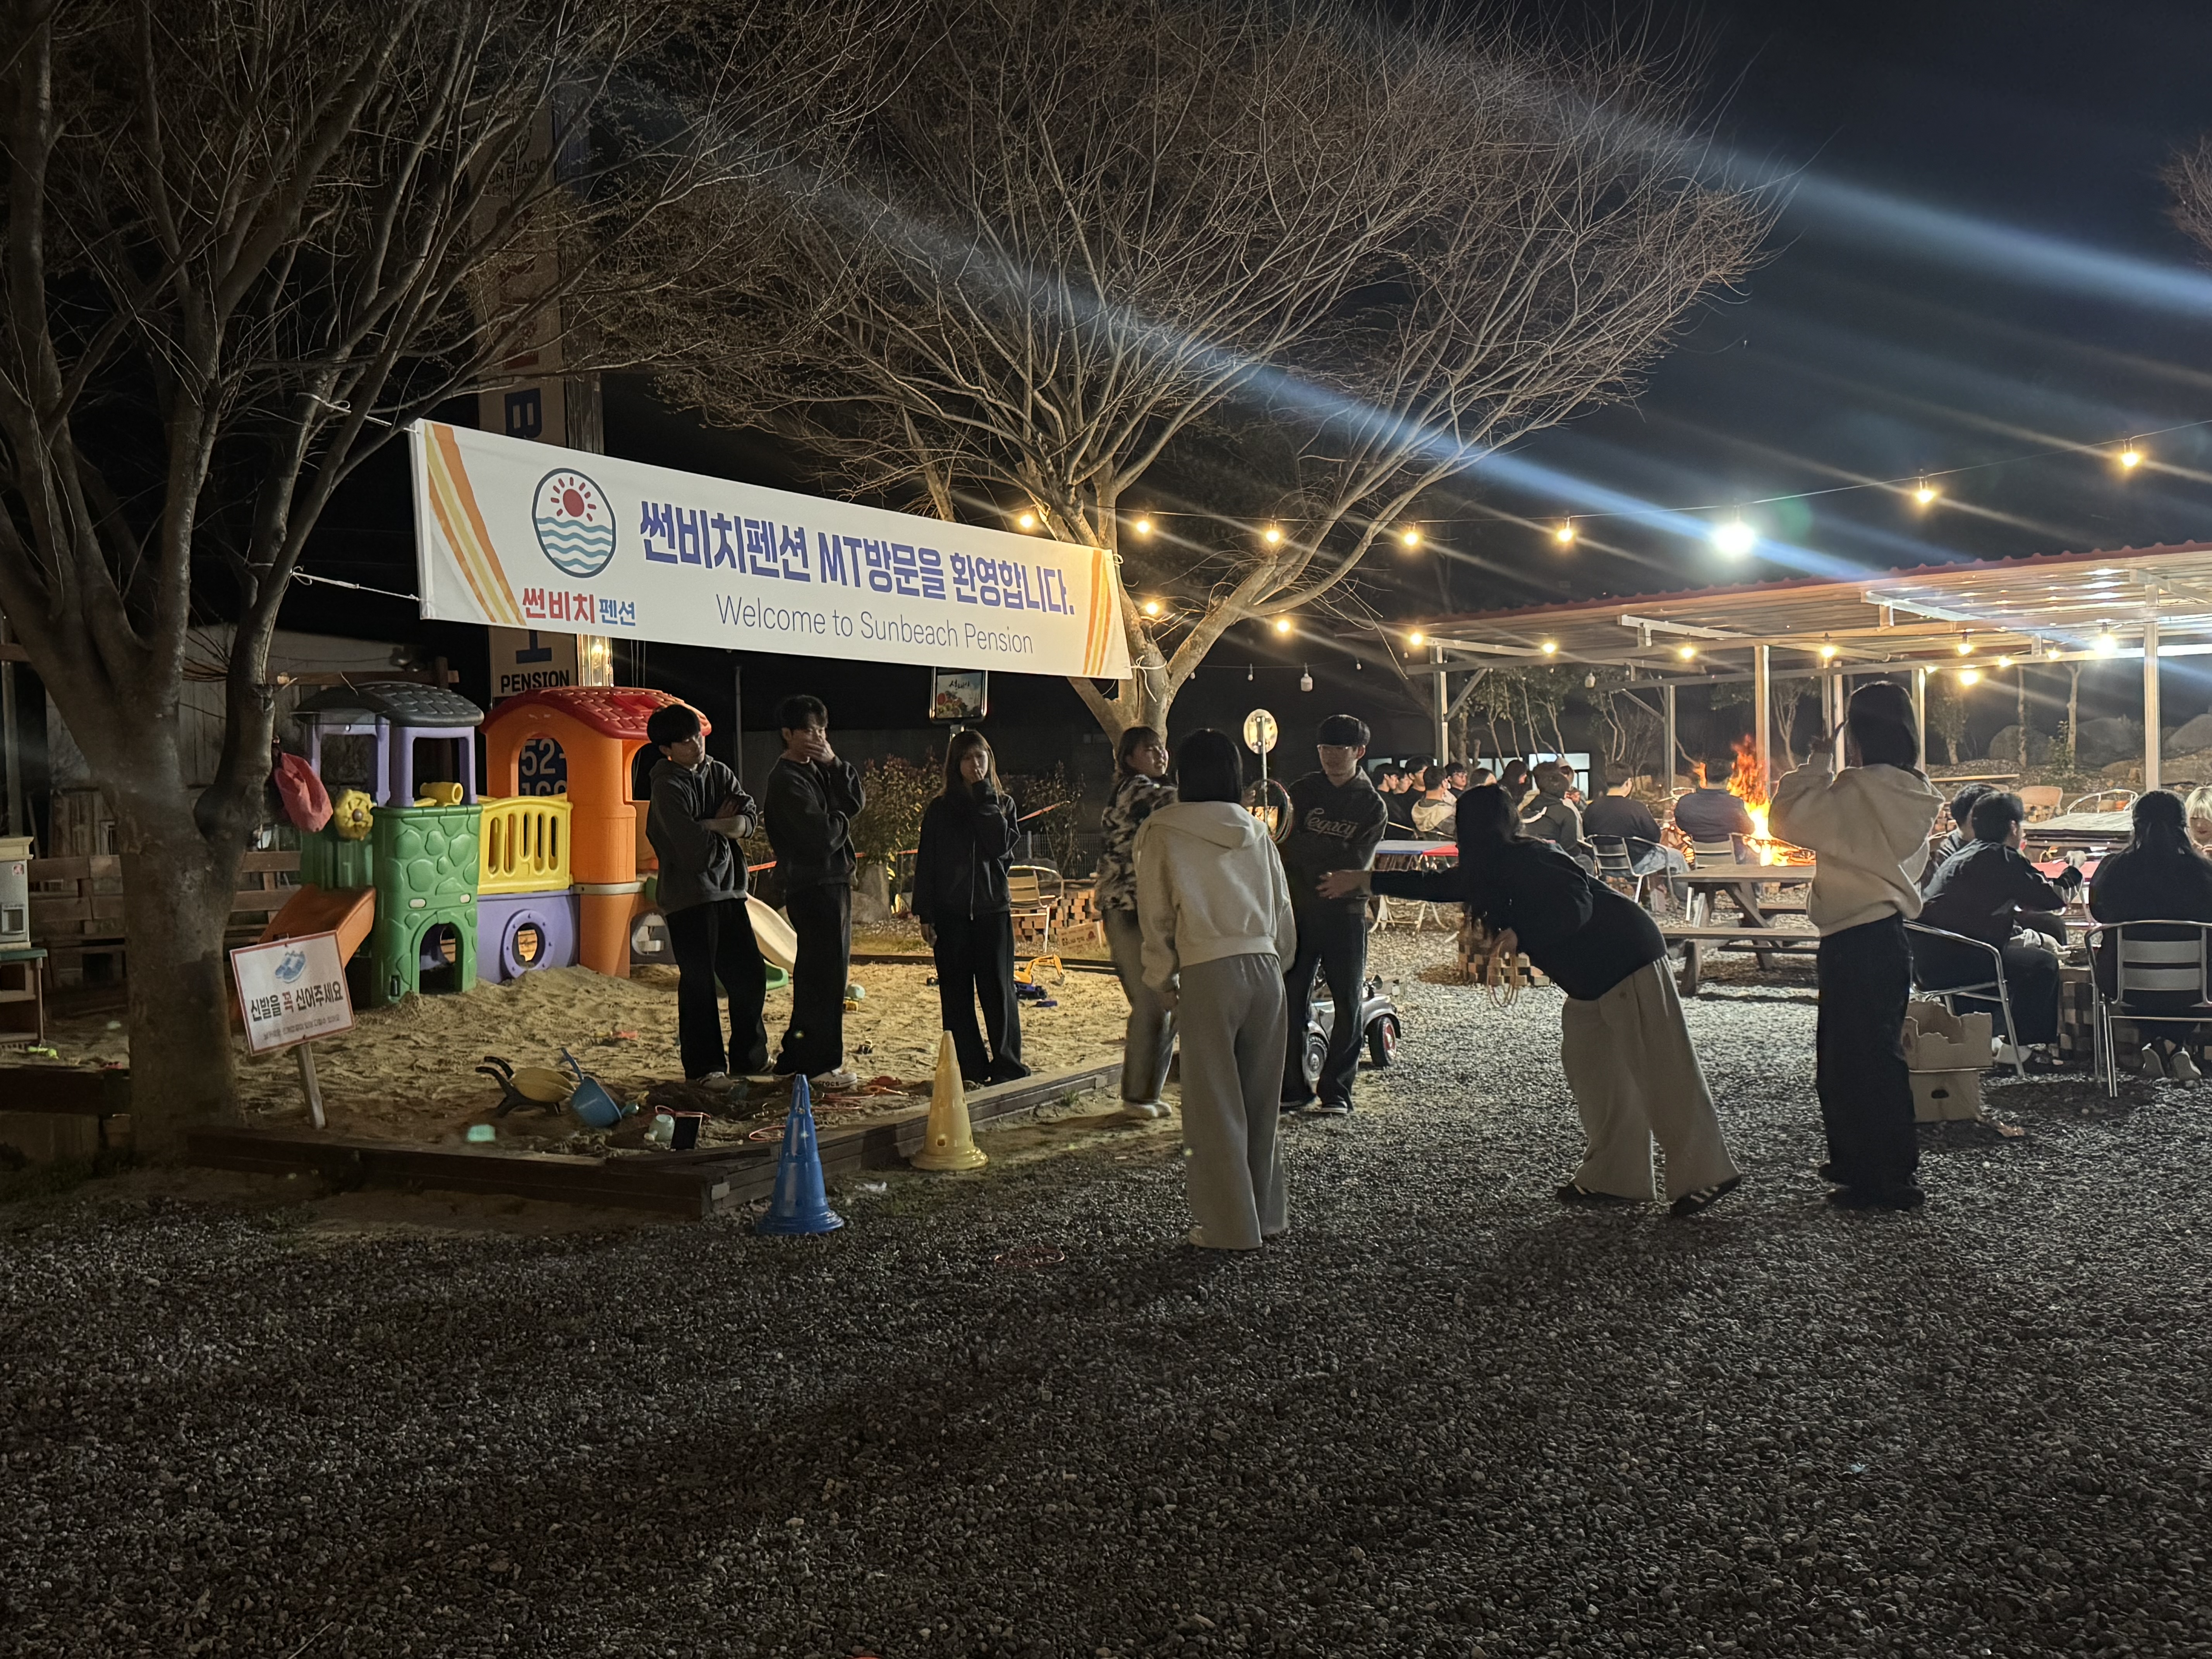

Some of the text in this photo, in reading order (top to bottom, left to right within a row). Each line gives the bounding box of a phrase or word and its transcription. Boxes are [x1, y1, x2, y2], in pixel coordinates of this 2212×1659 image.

[640, 501, 1075, 615] 썬비치펜션 MT방문을 환영합니다.
[522, 587, 636, 627] 썬비치 펜션
[716, 593, 1034, 654] Welcome to Sunbeach Pension
[501, 669, 569, 694] PENSION
[251, 981, 343, 1022] 신발을 꼭 신어주세요
